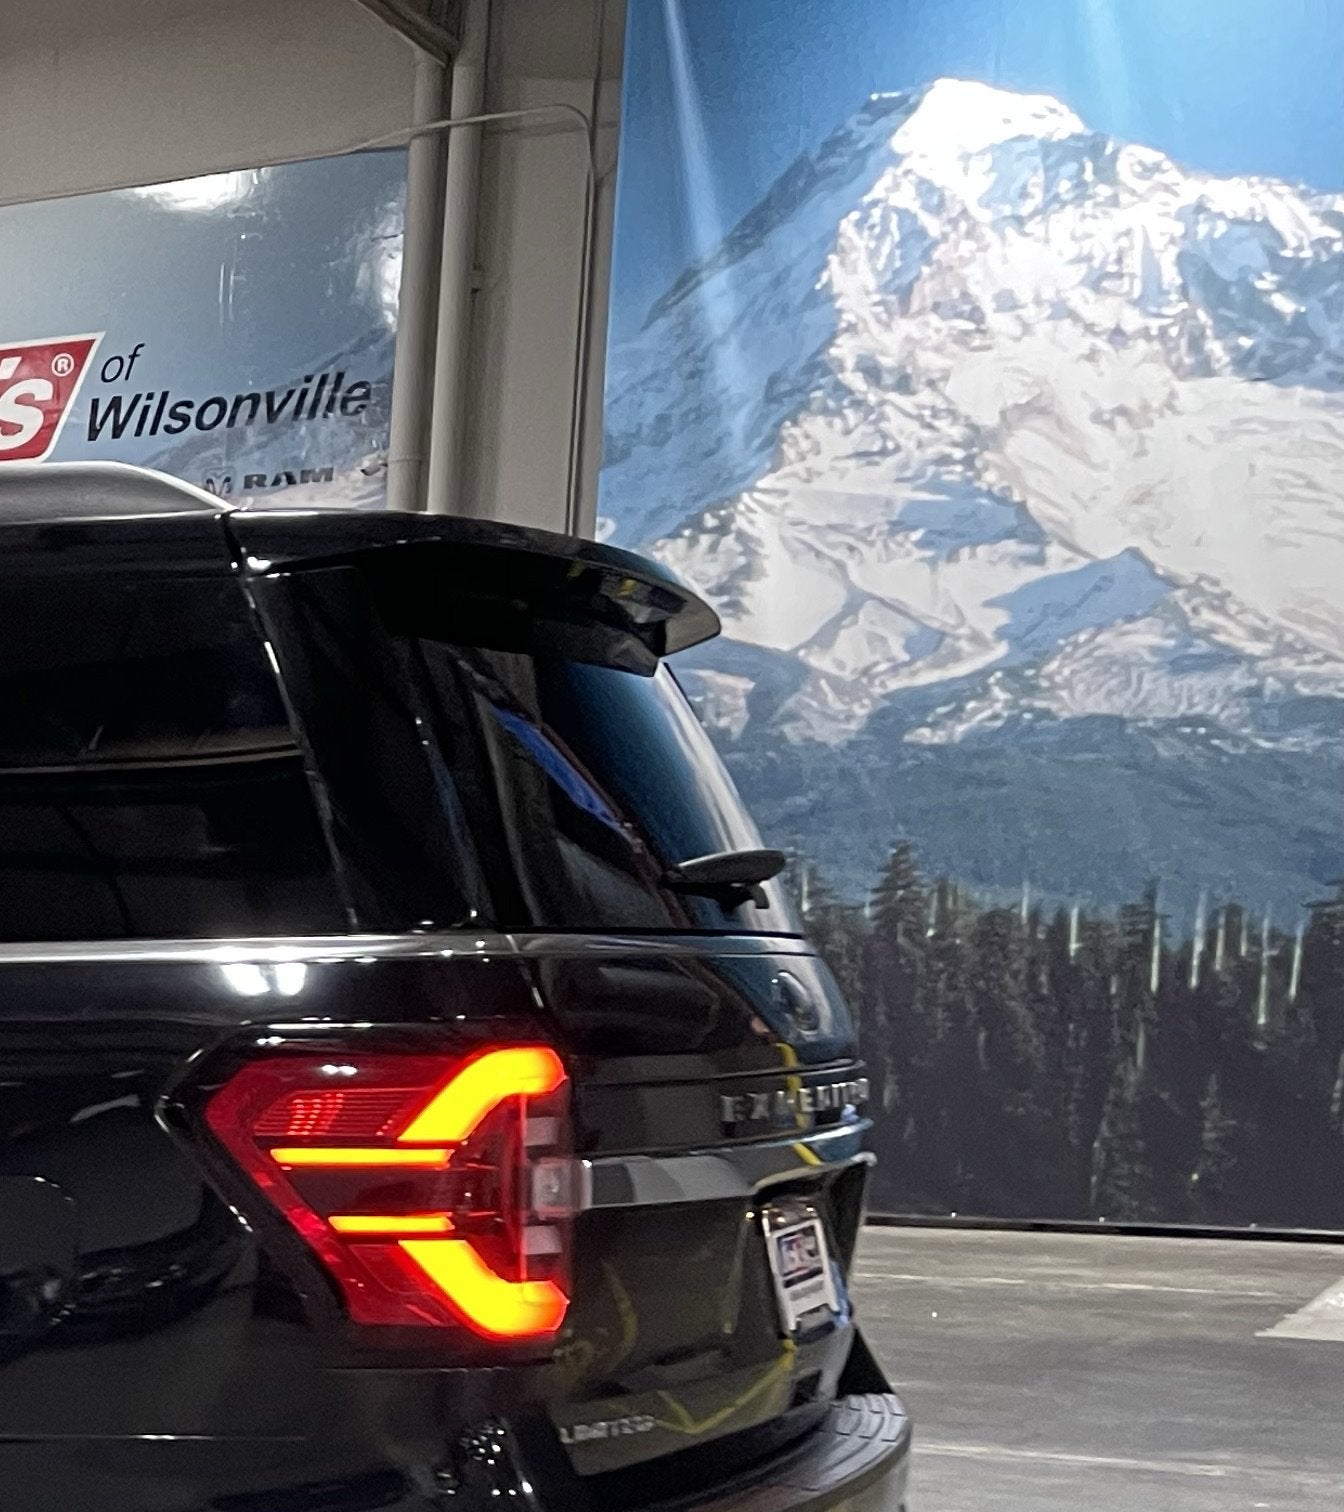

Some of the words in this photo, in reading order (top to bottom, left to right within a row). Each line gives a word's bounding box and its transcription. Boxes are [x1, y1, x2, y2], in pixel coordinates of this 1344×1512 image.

[100, 343, 145, 383] of
[87, 371, 372, 441] Wilsonville
[243, 467, 334, 489] RAM
